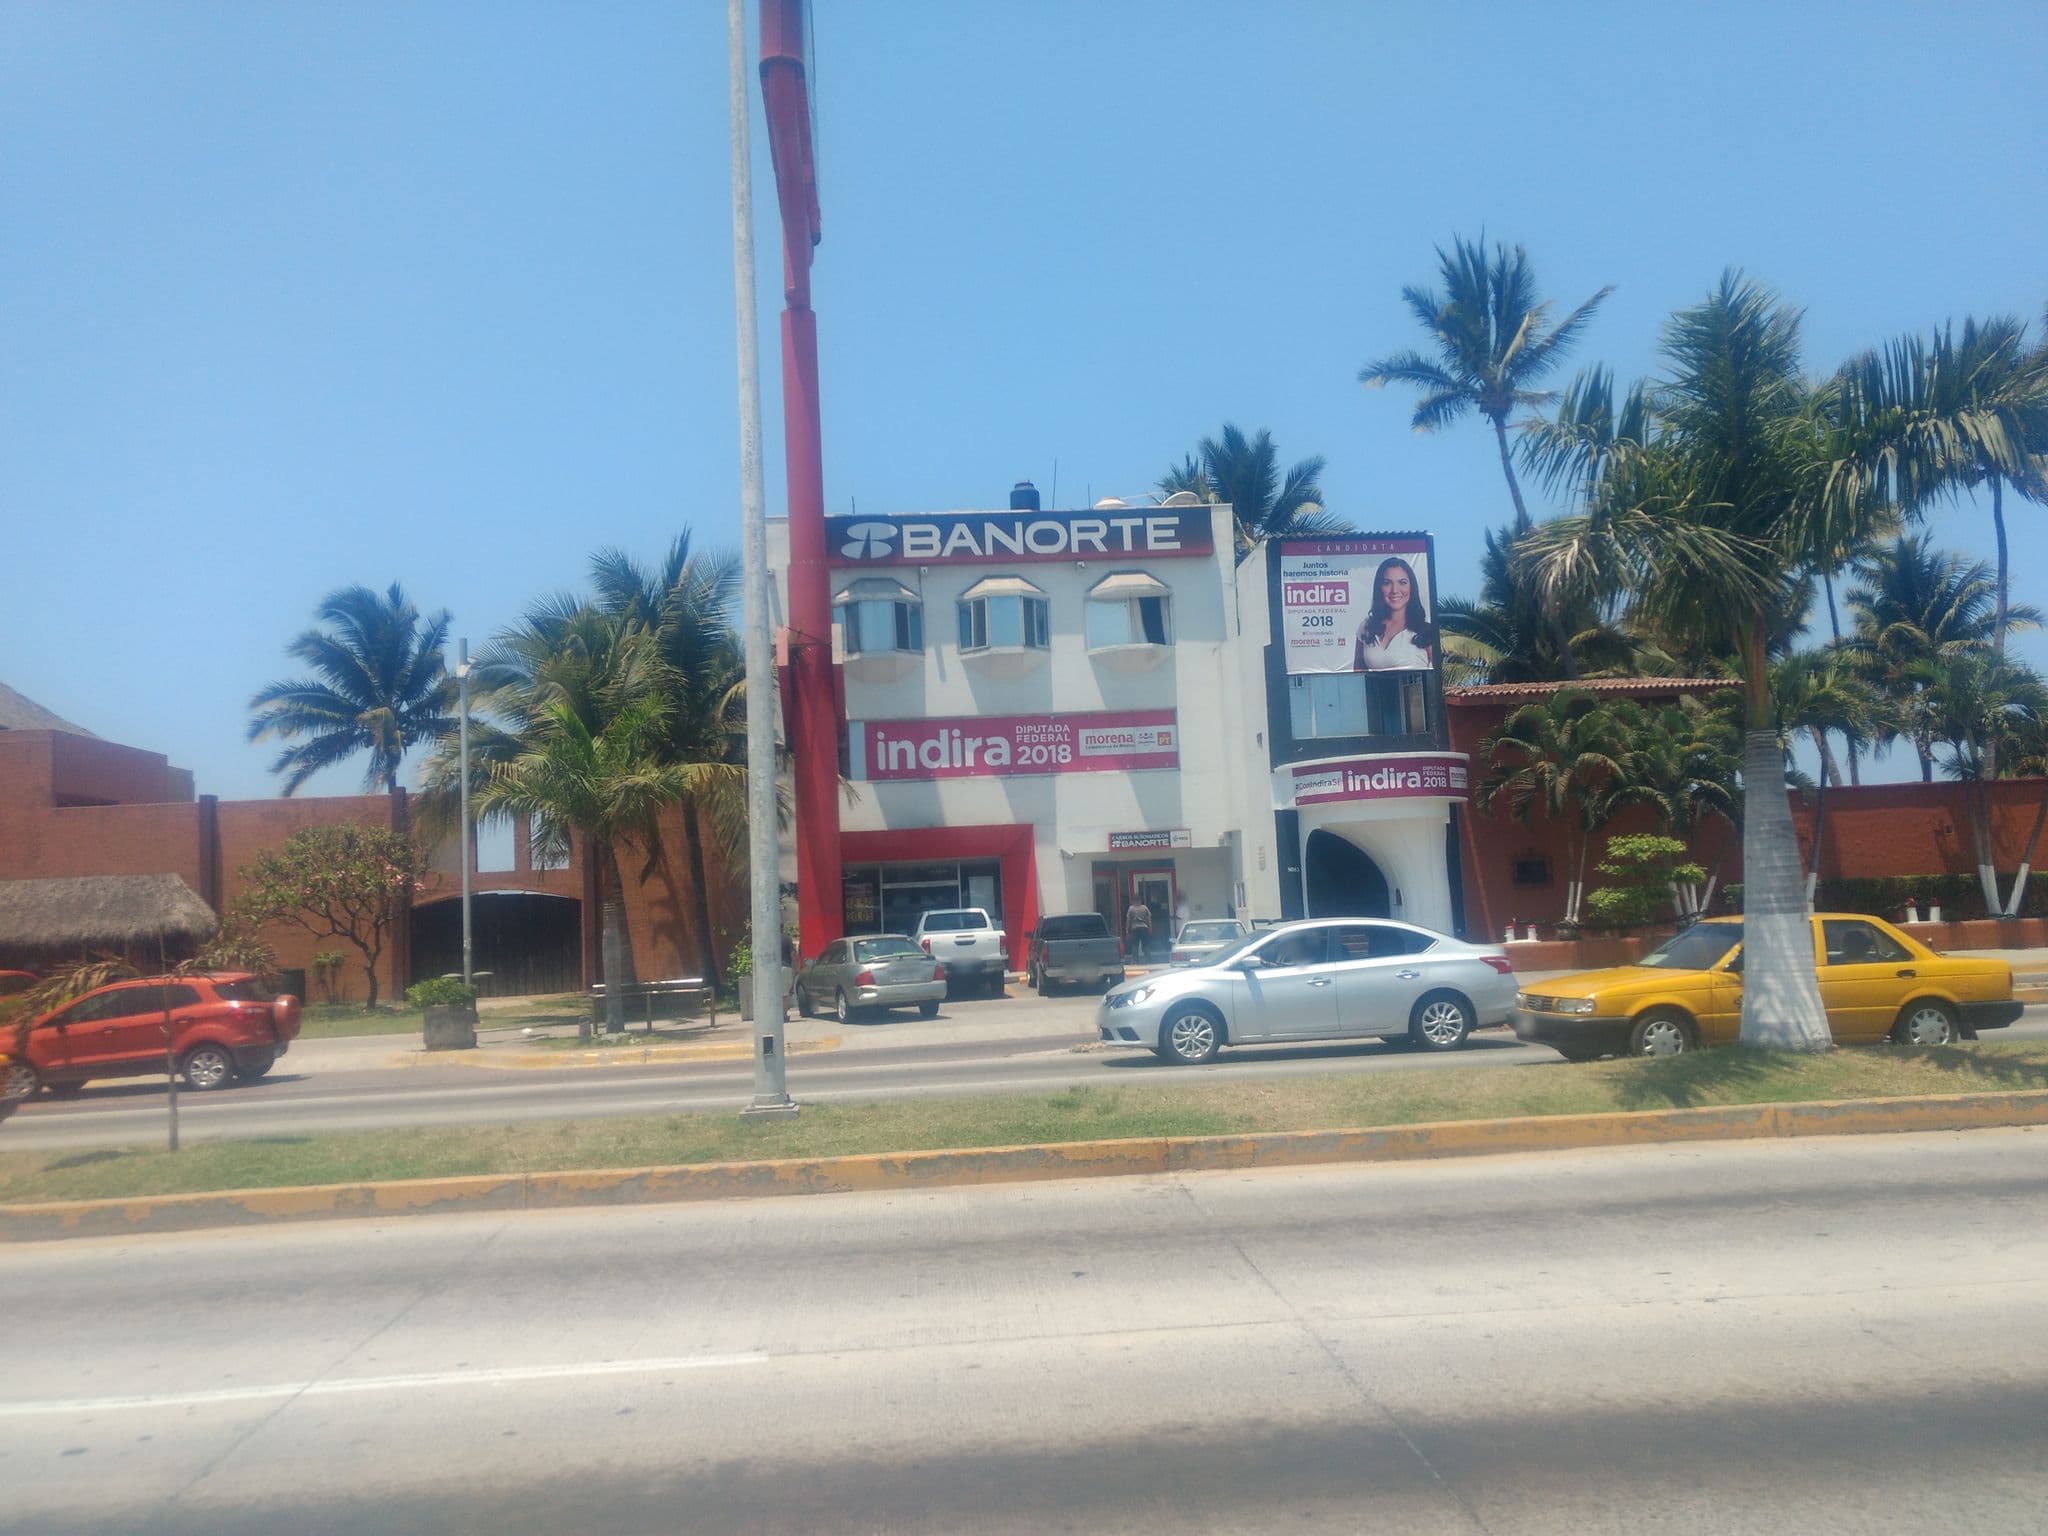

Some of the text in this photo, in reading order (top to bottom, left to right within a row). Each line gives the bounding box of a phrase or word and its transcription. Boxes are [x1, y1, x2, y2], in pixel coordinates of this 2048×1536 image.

[902, 516, 1182, 559] BANORTE
[1317, 543, 1395, 552] CANDIDATA
[1286, 585, 1347, 604] indira
[1302, 615, 1334, 627] 2018
[1015, 724, 1071, 734] DIPUTADA
[1016, 733, 1071, 743] FEDERAL
[1085, 732, 1134, 745] morena
[876, 729, 1011, 771] indira
[1017, 744, 1072, 766] 2018
[1347, 767, 1421, 792] indira
[1423, 776, 1447, 788] 2018
[1121, 839, 1170, 848] BANORTE
